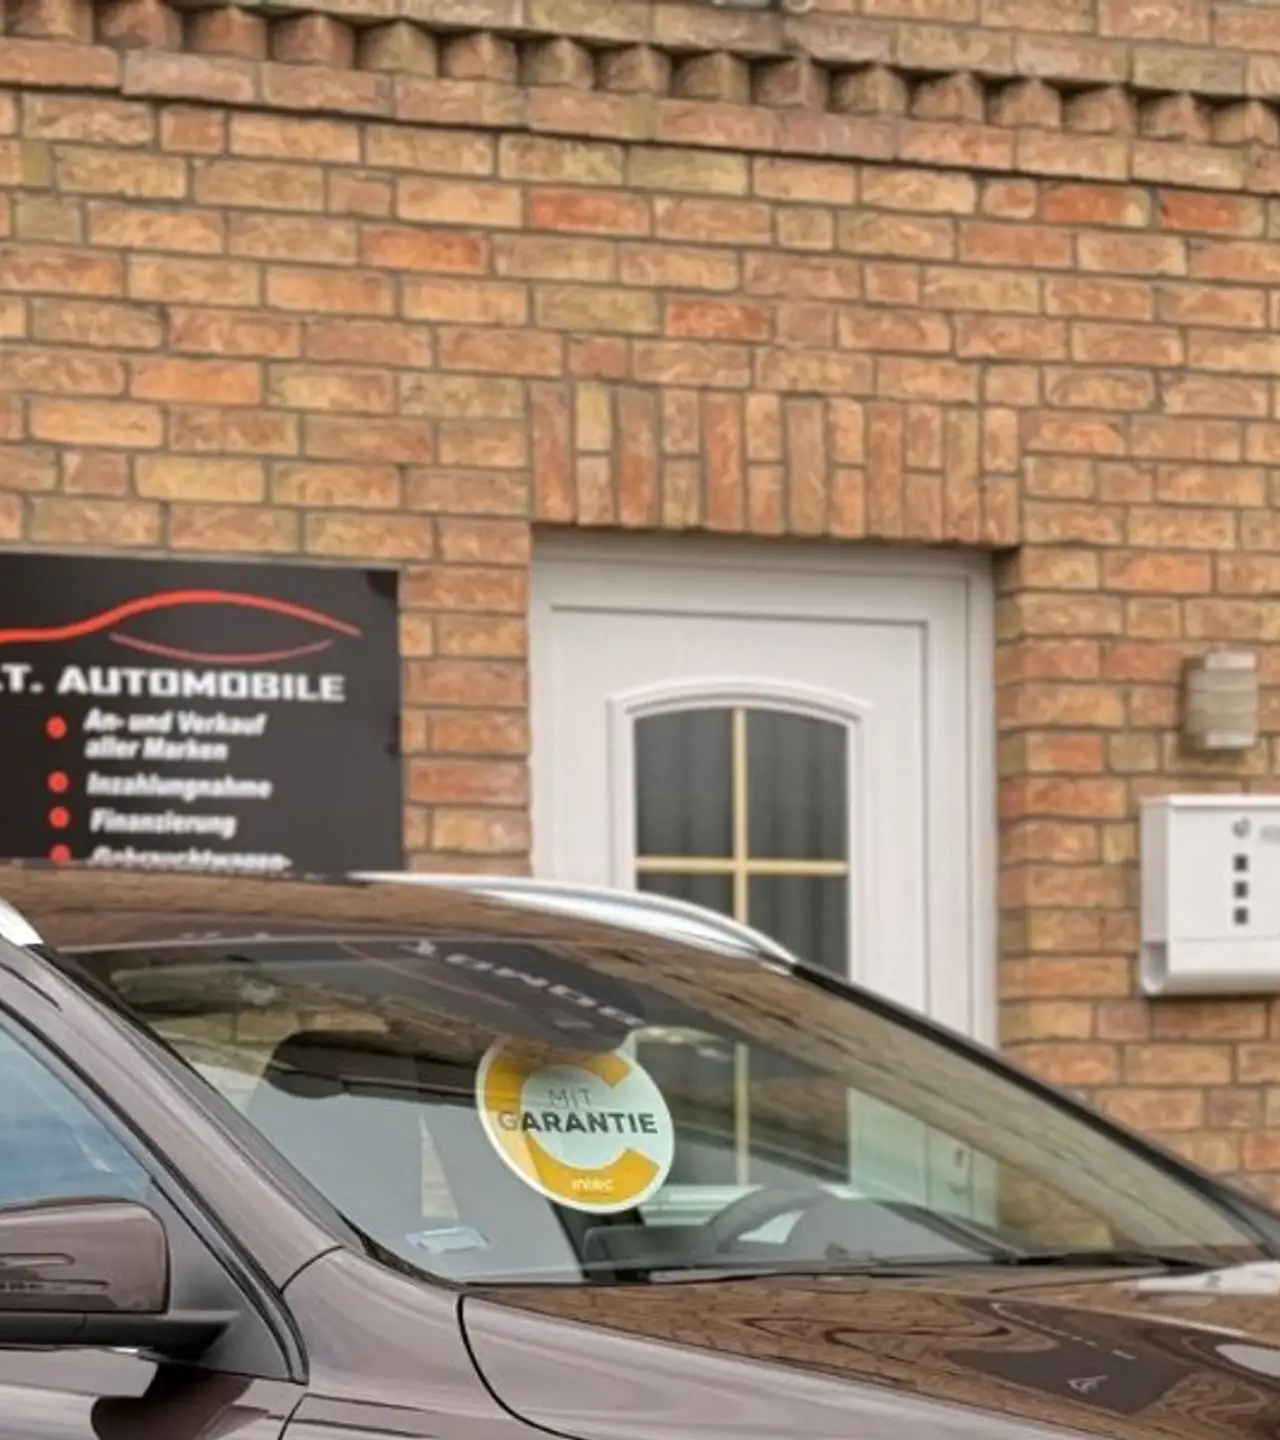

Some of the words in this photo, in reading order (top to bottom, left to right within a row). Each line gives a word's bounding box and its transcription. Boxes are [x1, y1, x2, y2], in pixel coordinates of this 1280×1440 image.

[56, 665, 347, 702] AUTOMOBILE
[83, 707, 125, 732] An-
[128, 709, 173, 733] und
[177, 710, 267, 736] Verkauf
[84, 735, 140, 759] aller
[142, 736, 229, 761] Marken
[86, 771, 273, 802] Inzahlungnahme
[90, 808, 237, 839] Finanzierung
[549, 1087, 591, 1109] MIT
[499, 1111, 658, 1133] GARANTIE
